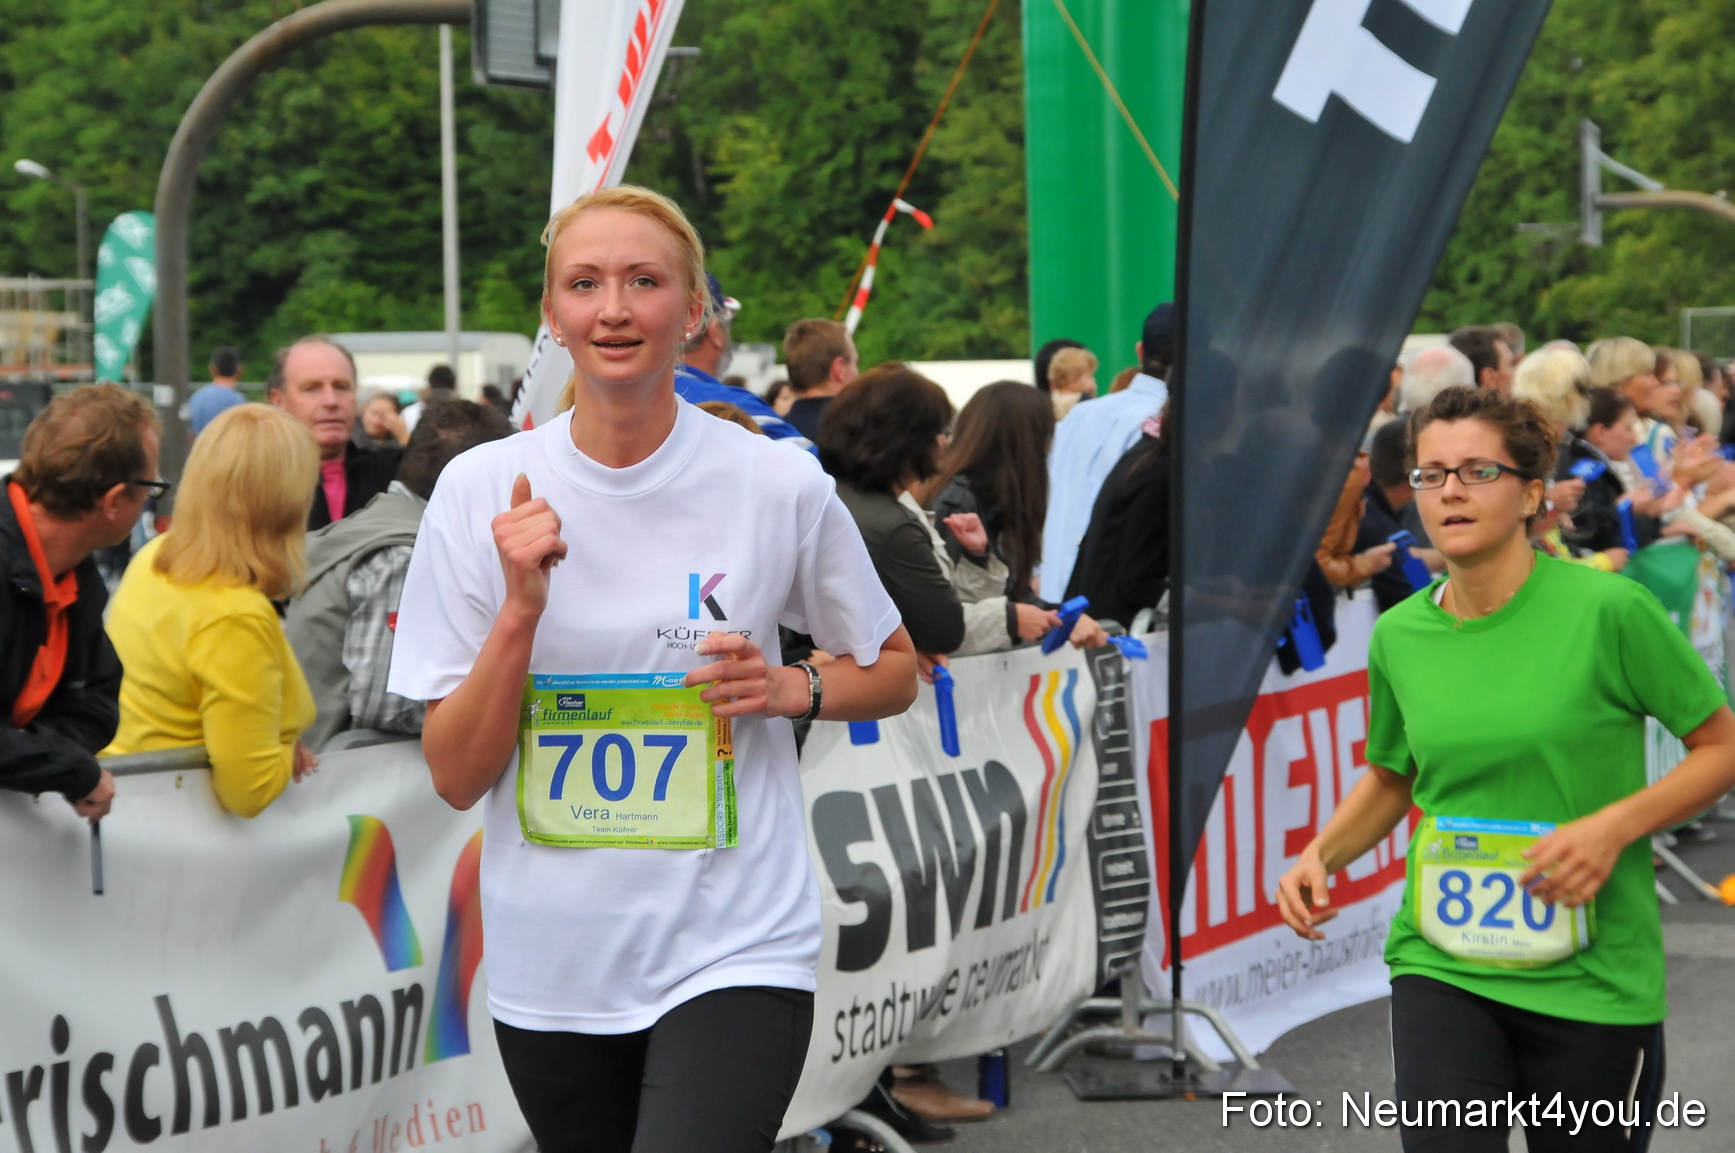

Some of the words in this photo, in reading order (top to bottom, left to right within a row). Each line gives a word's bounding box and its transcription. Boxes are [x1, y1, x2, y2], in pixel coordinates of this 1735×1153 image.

[657, 626, 752, 641] KÜFR
[543, 708, 613, 721] firmenlauf
[538, 733, 688, 801] 707
[570, 805, 610, 820] Vera
[615, 812, 659, 821] Hartmann
[592, 826, 611, 834] Team
[613, 825, 638, 834] Küfner
[1437, 870, 1556, 932] 820
[1462, 932, 1508, 946] Kirstin
[0, 982, 425, 1153] rischmann
